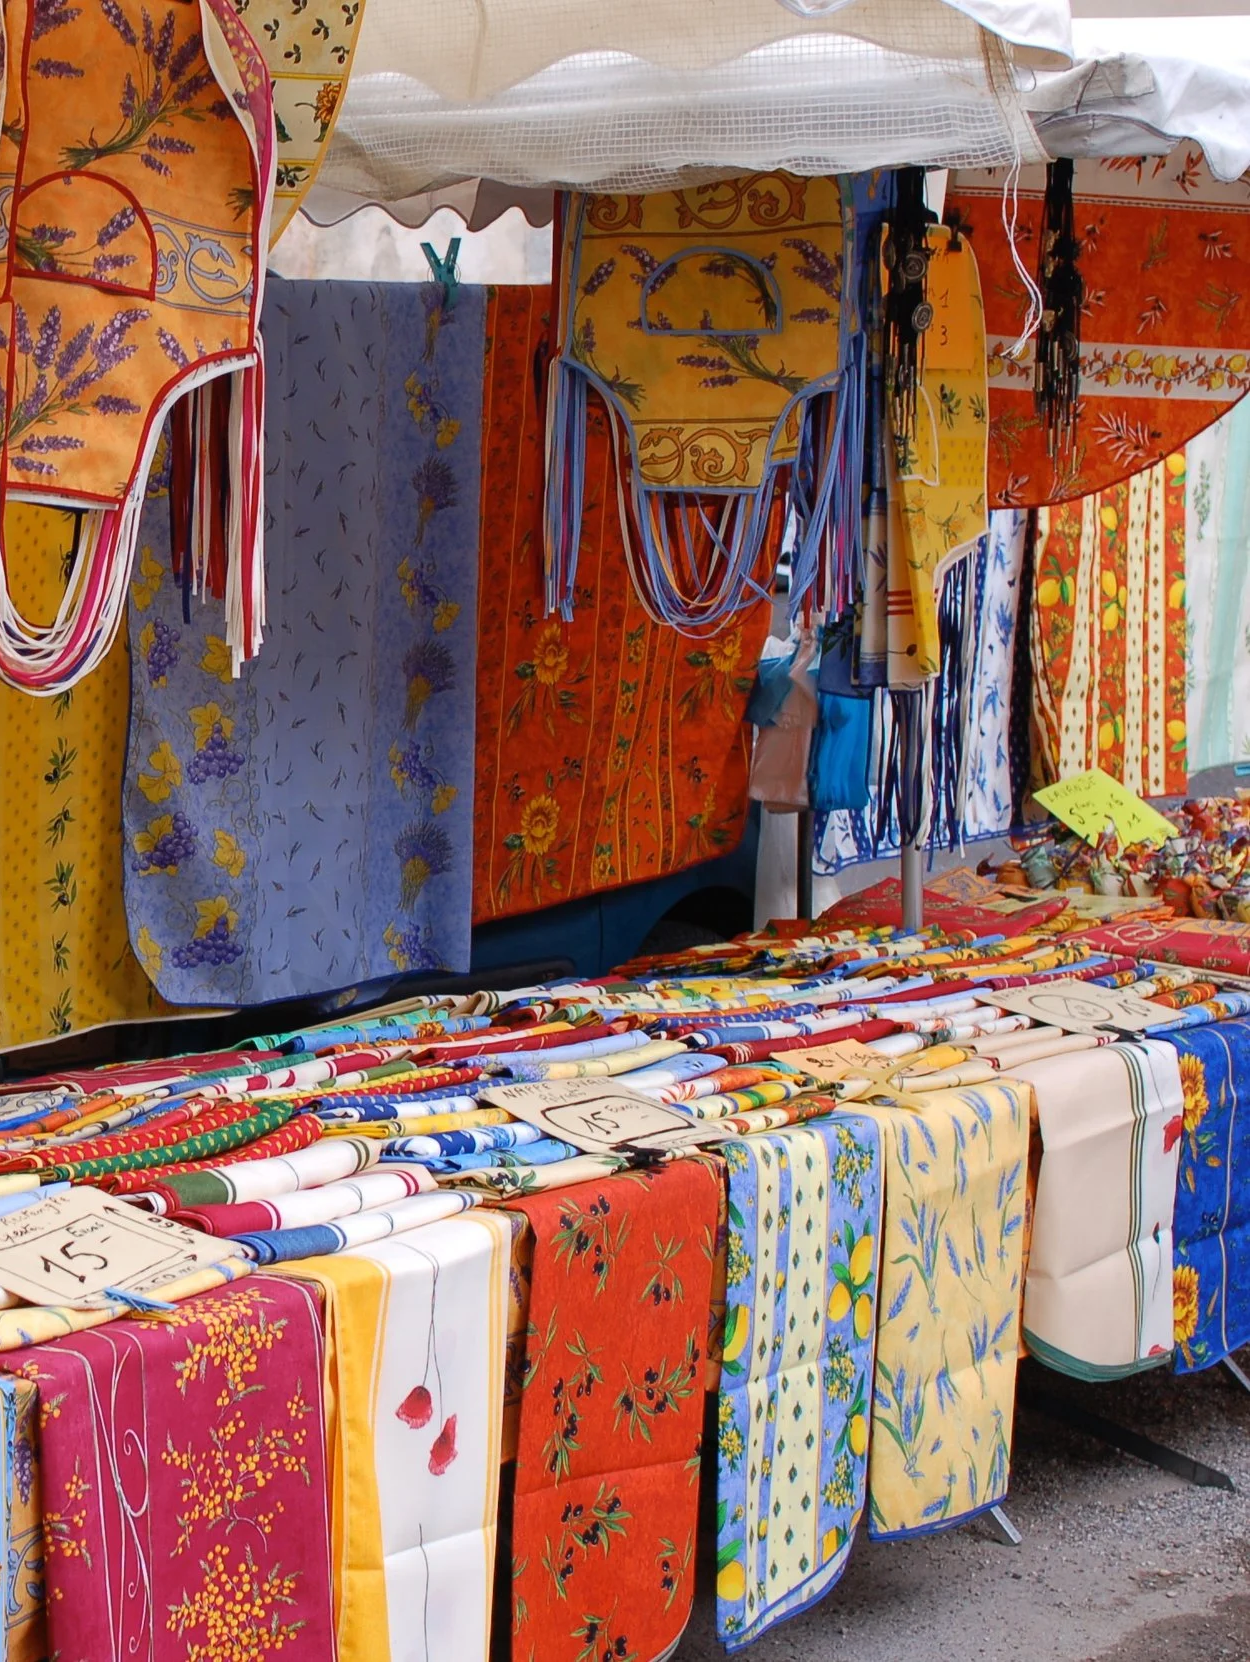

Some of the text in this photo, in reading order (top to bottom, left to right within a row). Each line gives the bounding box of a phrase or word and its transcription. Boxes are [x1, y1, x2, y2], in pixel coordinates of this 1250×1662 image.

[1115, 998, 1152, 1018] 15
[577, 1110, 621, 1136] 15
[39, 1239, 109, 1284] 15
